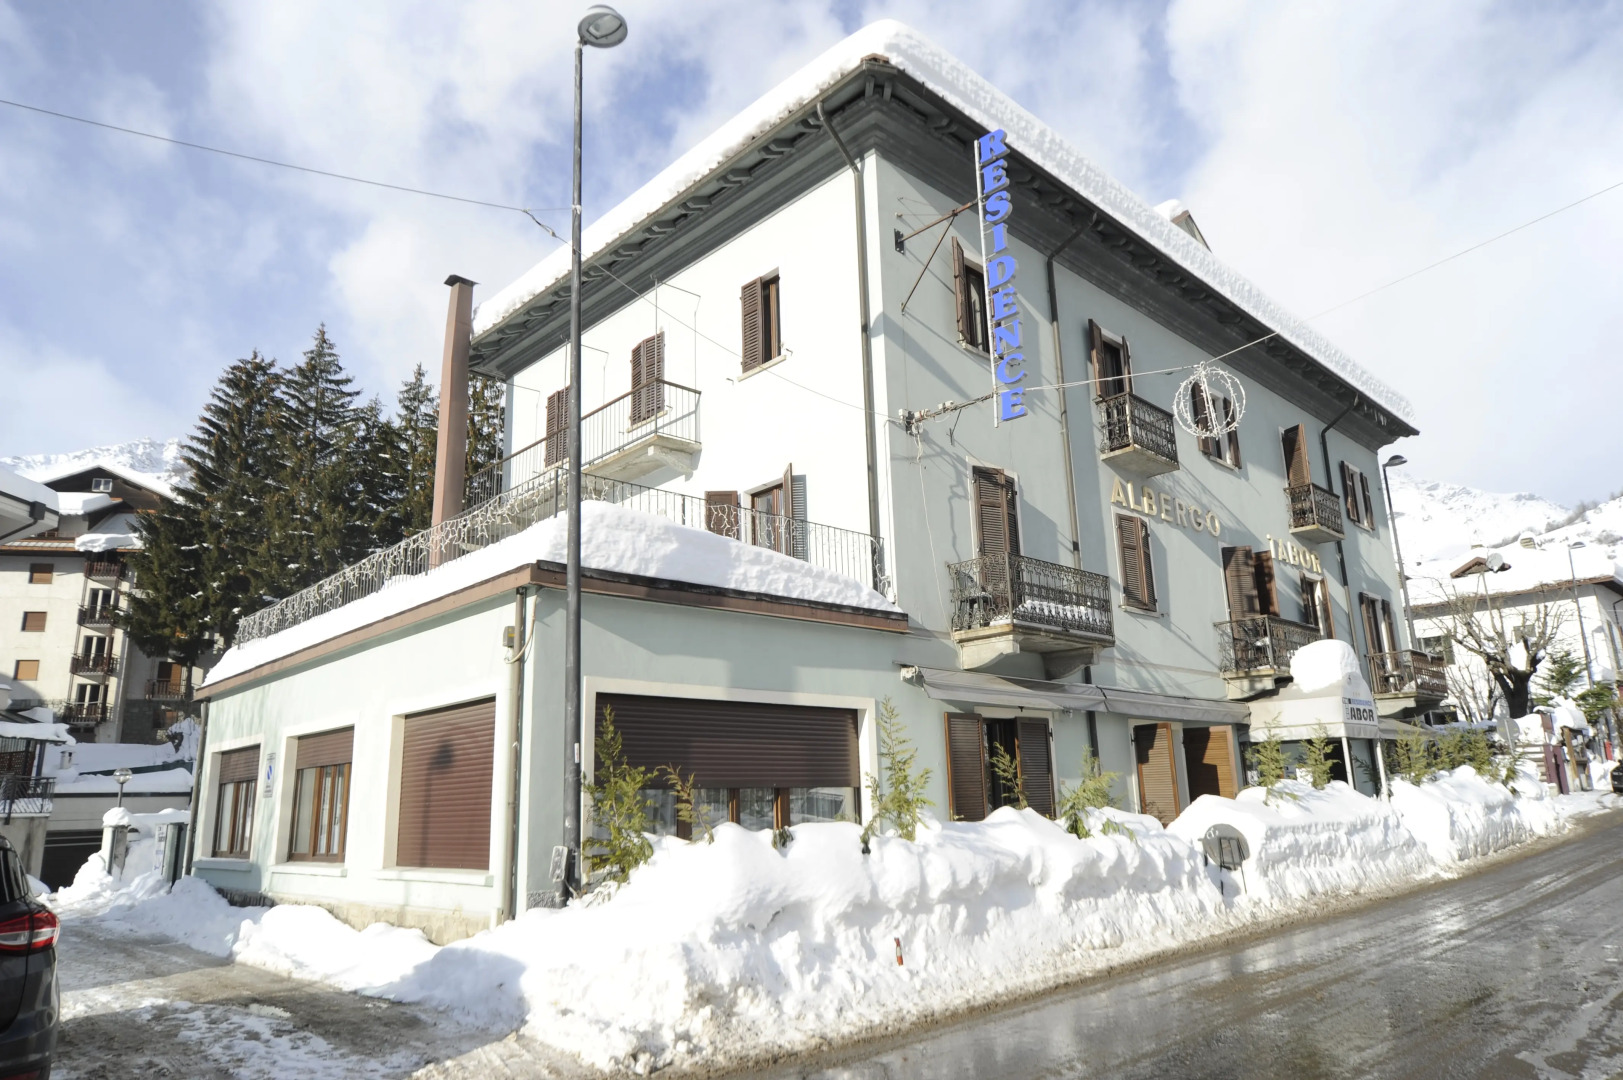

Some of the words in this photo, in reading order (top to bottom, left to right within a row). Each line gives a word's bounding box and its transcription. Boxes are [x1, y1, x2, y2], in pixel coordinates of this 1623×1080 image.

[979, 128, 1027, 421] RESIDENCE
[1111, 475, 1221, 537] ALBERGO
[1266, 534, 1322, 574] TABOR
